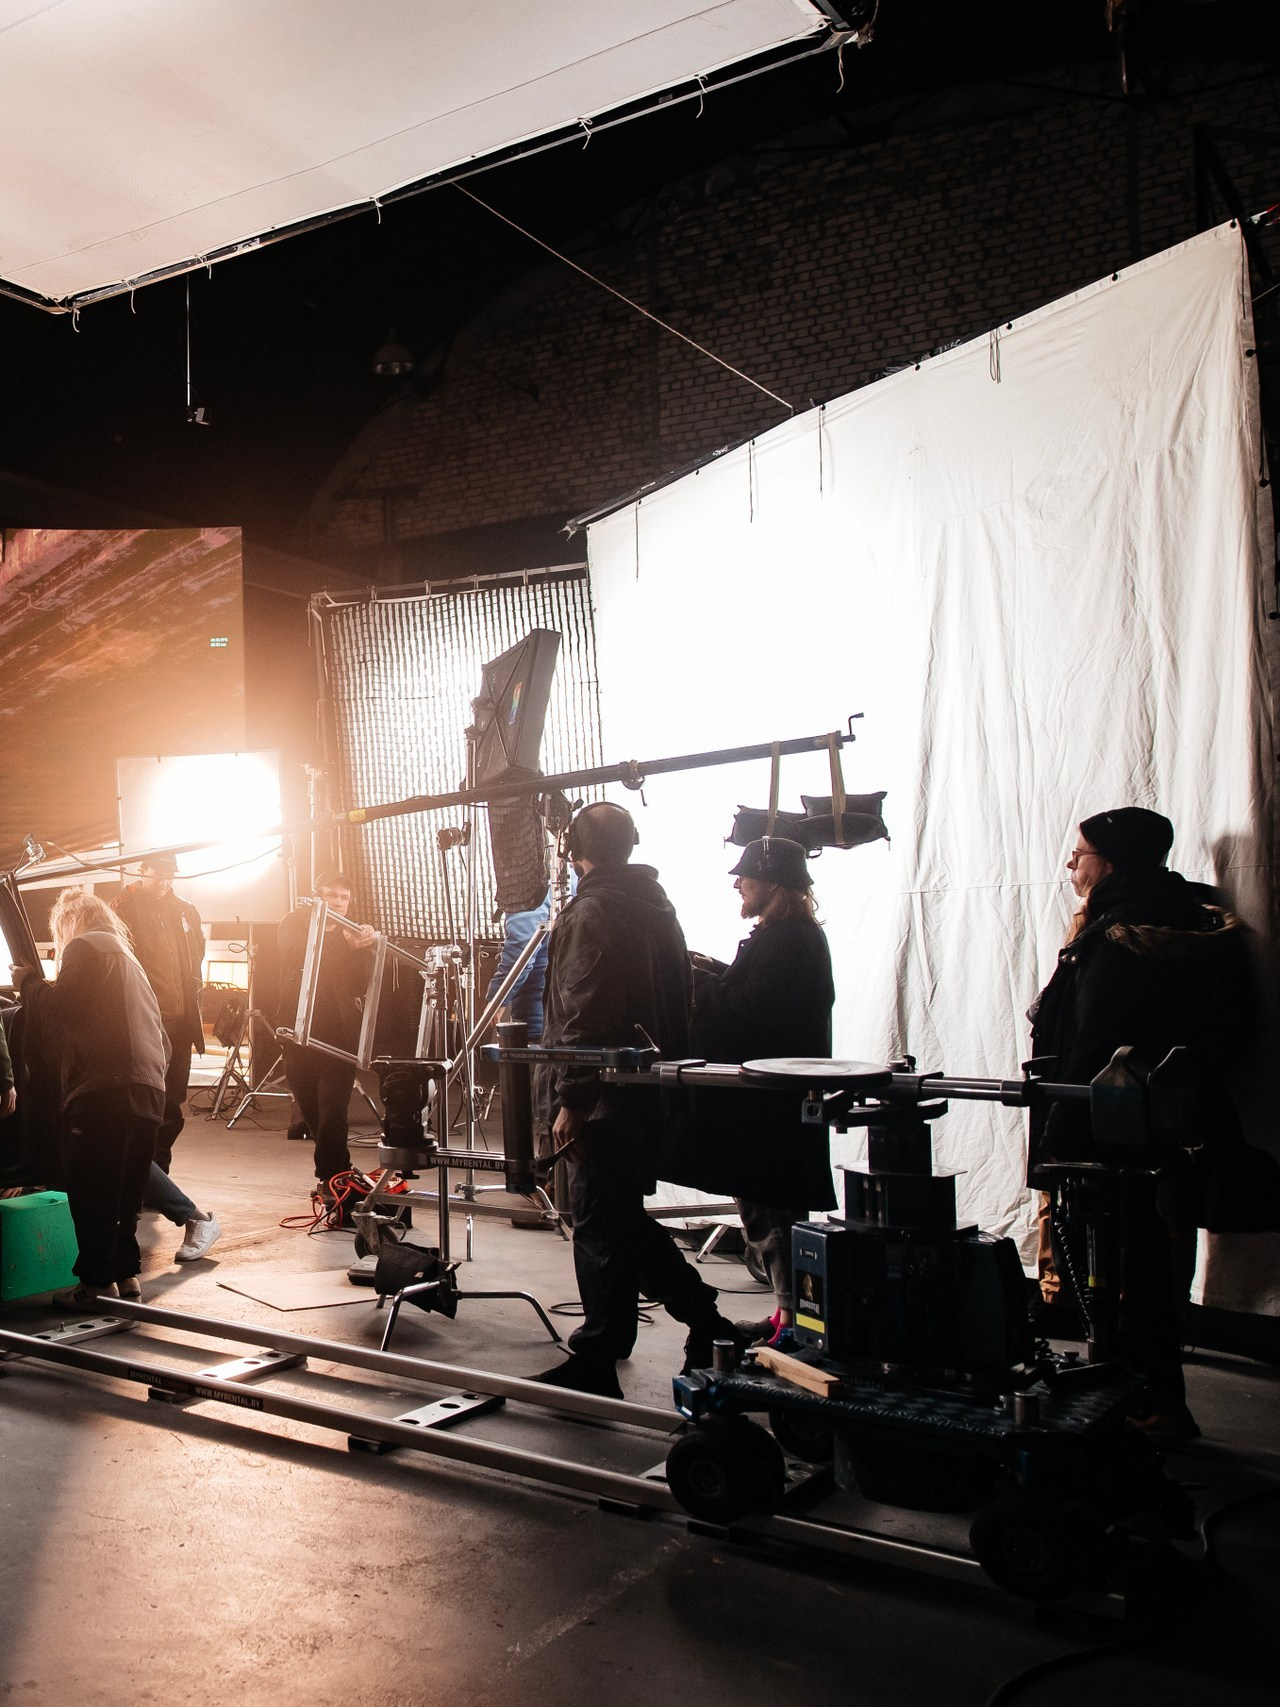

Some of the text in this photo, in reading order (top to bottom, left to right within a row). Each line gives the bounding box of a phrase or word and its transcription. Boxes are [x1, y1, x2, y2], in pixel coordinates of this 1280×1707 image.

[429, 1155, 505, 1170] WWW.MYRENTAL.BY
[129, 1370, 162, 1384] MYRENTAL
[194, 1386, 261, 1408] WWW.MYRENTAL.BY
